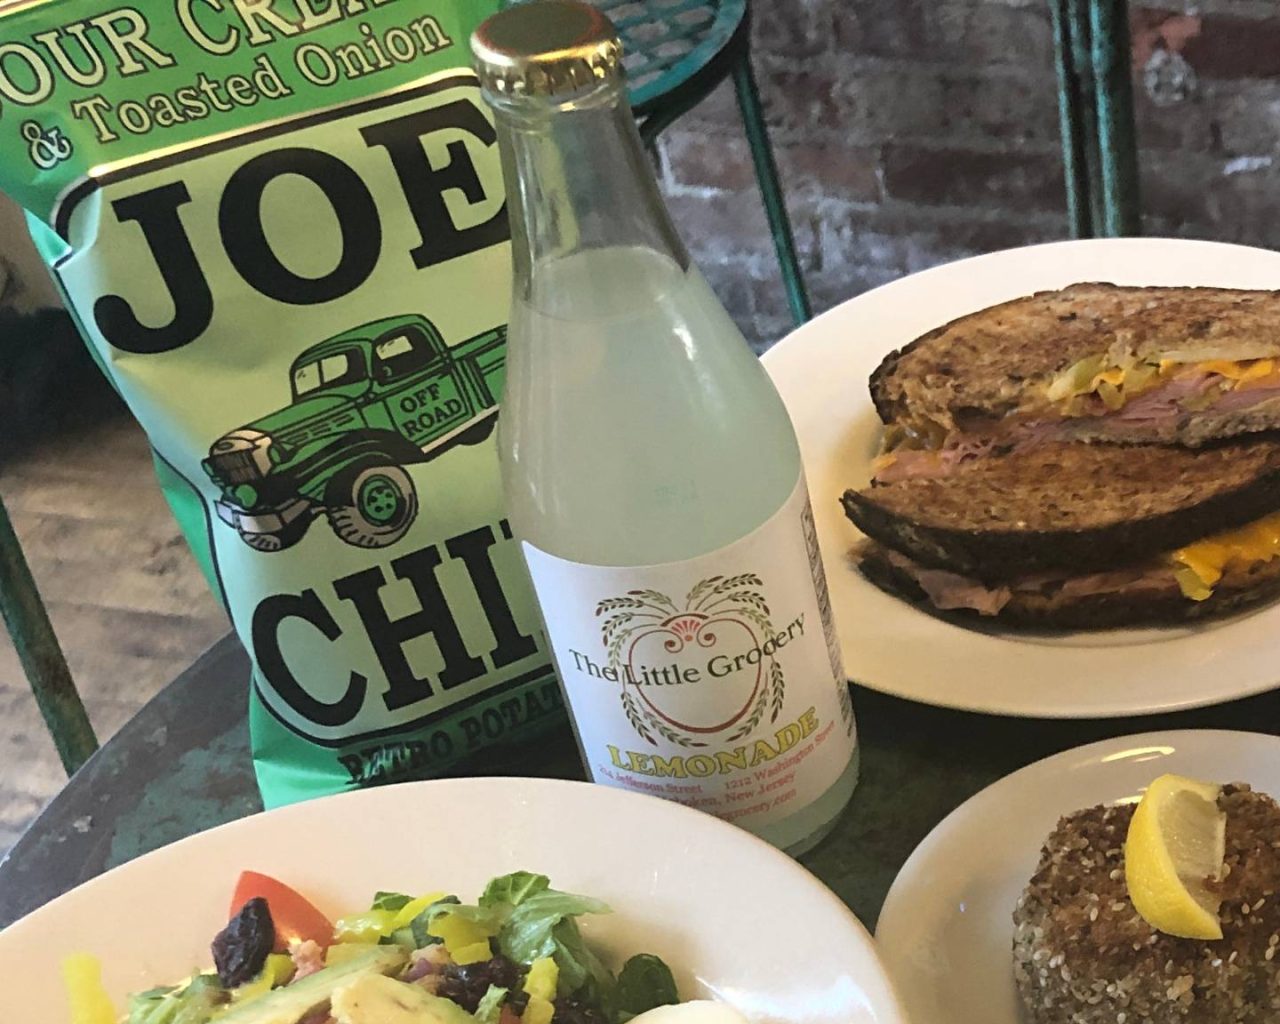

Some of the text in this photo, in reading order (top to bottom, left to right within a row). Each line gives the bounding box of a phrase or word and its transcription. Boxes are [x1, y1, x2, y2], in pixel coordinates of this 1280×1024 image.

[0, 0, 400, 107] OUR CRE
[20, 13, 452, 171] & Toasted Onion
[94, 98, 512, 354] JOE
[400, 382, 443, 415] OFF
[402, 399, 464, 438] ROAD
[251, 519, 540, 728] CHI
[569, 612, 806, 687] The Little Grocery
[460, 683, 564, 748] POTAT
[607, 706, 820, 778] LEMONADE
[725, 776, 753, 790] 1212
[754, 742, 814, 781] Washington
[725, 790, 755, 804] New
[757, 772, 796, 796] Jersey
